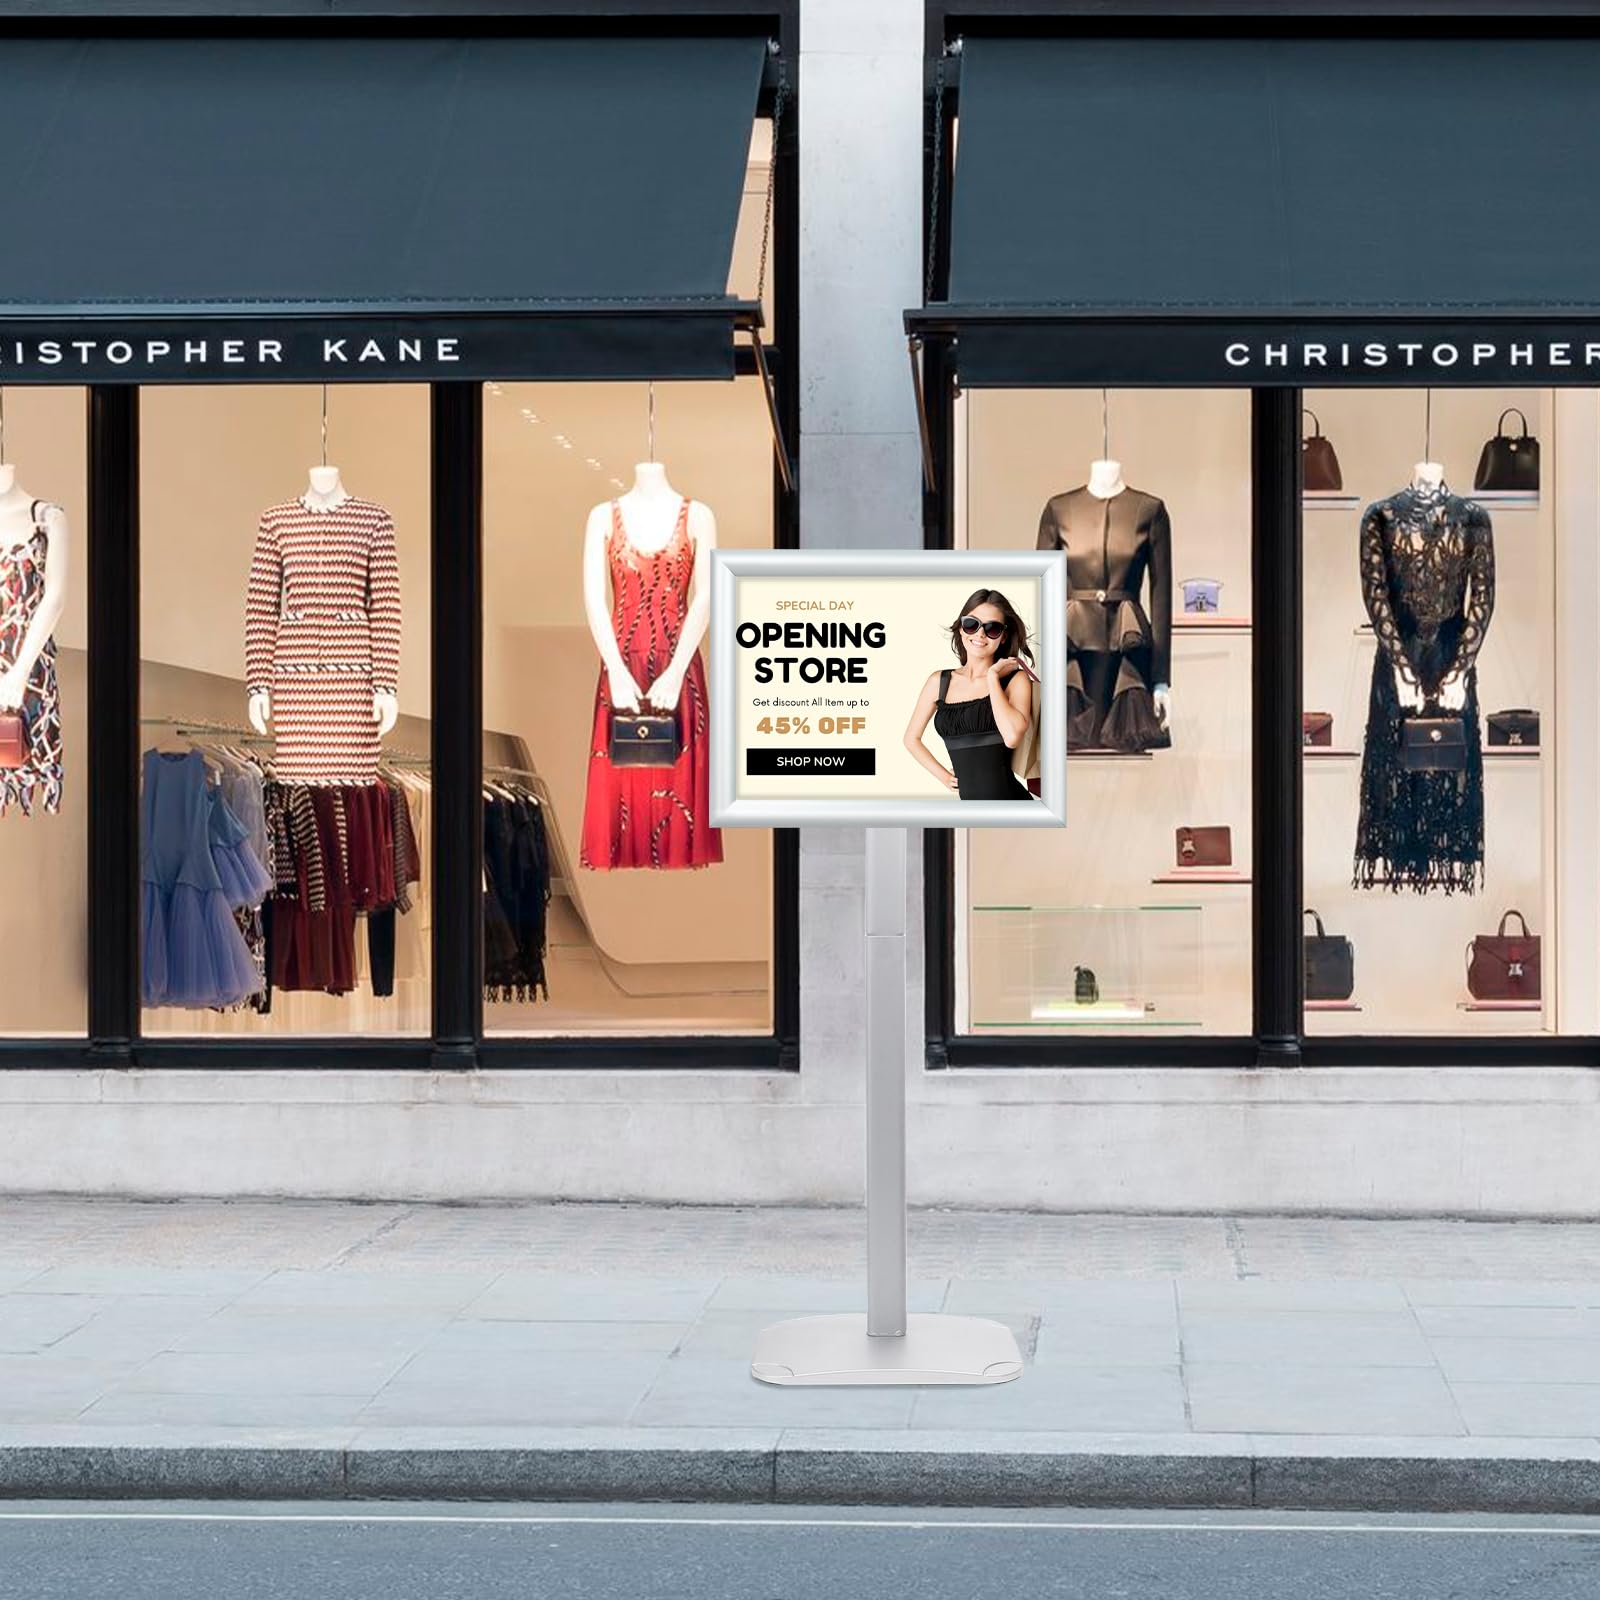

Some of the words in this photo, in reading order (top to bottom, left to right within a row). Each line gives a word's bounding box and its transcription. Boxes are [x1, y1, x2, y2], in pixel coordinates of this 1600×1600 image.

[0, 340, 282, 364] ISTOPHER
[323, 338, 460, 362] KANE
[1225, 342, 1600, 367] CHRISTOPHER
[775, 600, 826, 611] SPECIAL
[829, 600, 855, 611] DAY
[735, 622, 886, 649] OPENING
[754, 657, 868, 684] STORE
[752, 697, 770, 707] Get
[772, 696, 810, 707] discount
[811, 696, 823, 707] All
[825, 697, 845, 707] Item
[847, 700, 858, 710] up
[860, 698, 870, 707] to
[756, 717, 811, 735] 45%
[818, 717, 866, 735] OFF
[776, 756, 811, 767] SHOP
[814, 756, 846, 767] NOW
